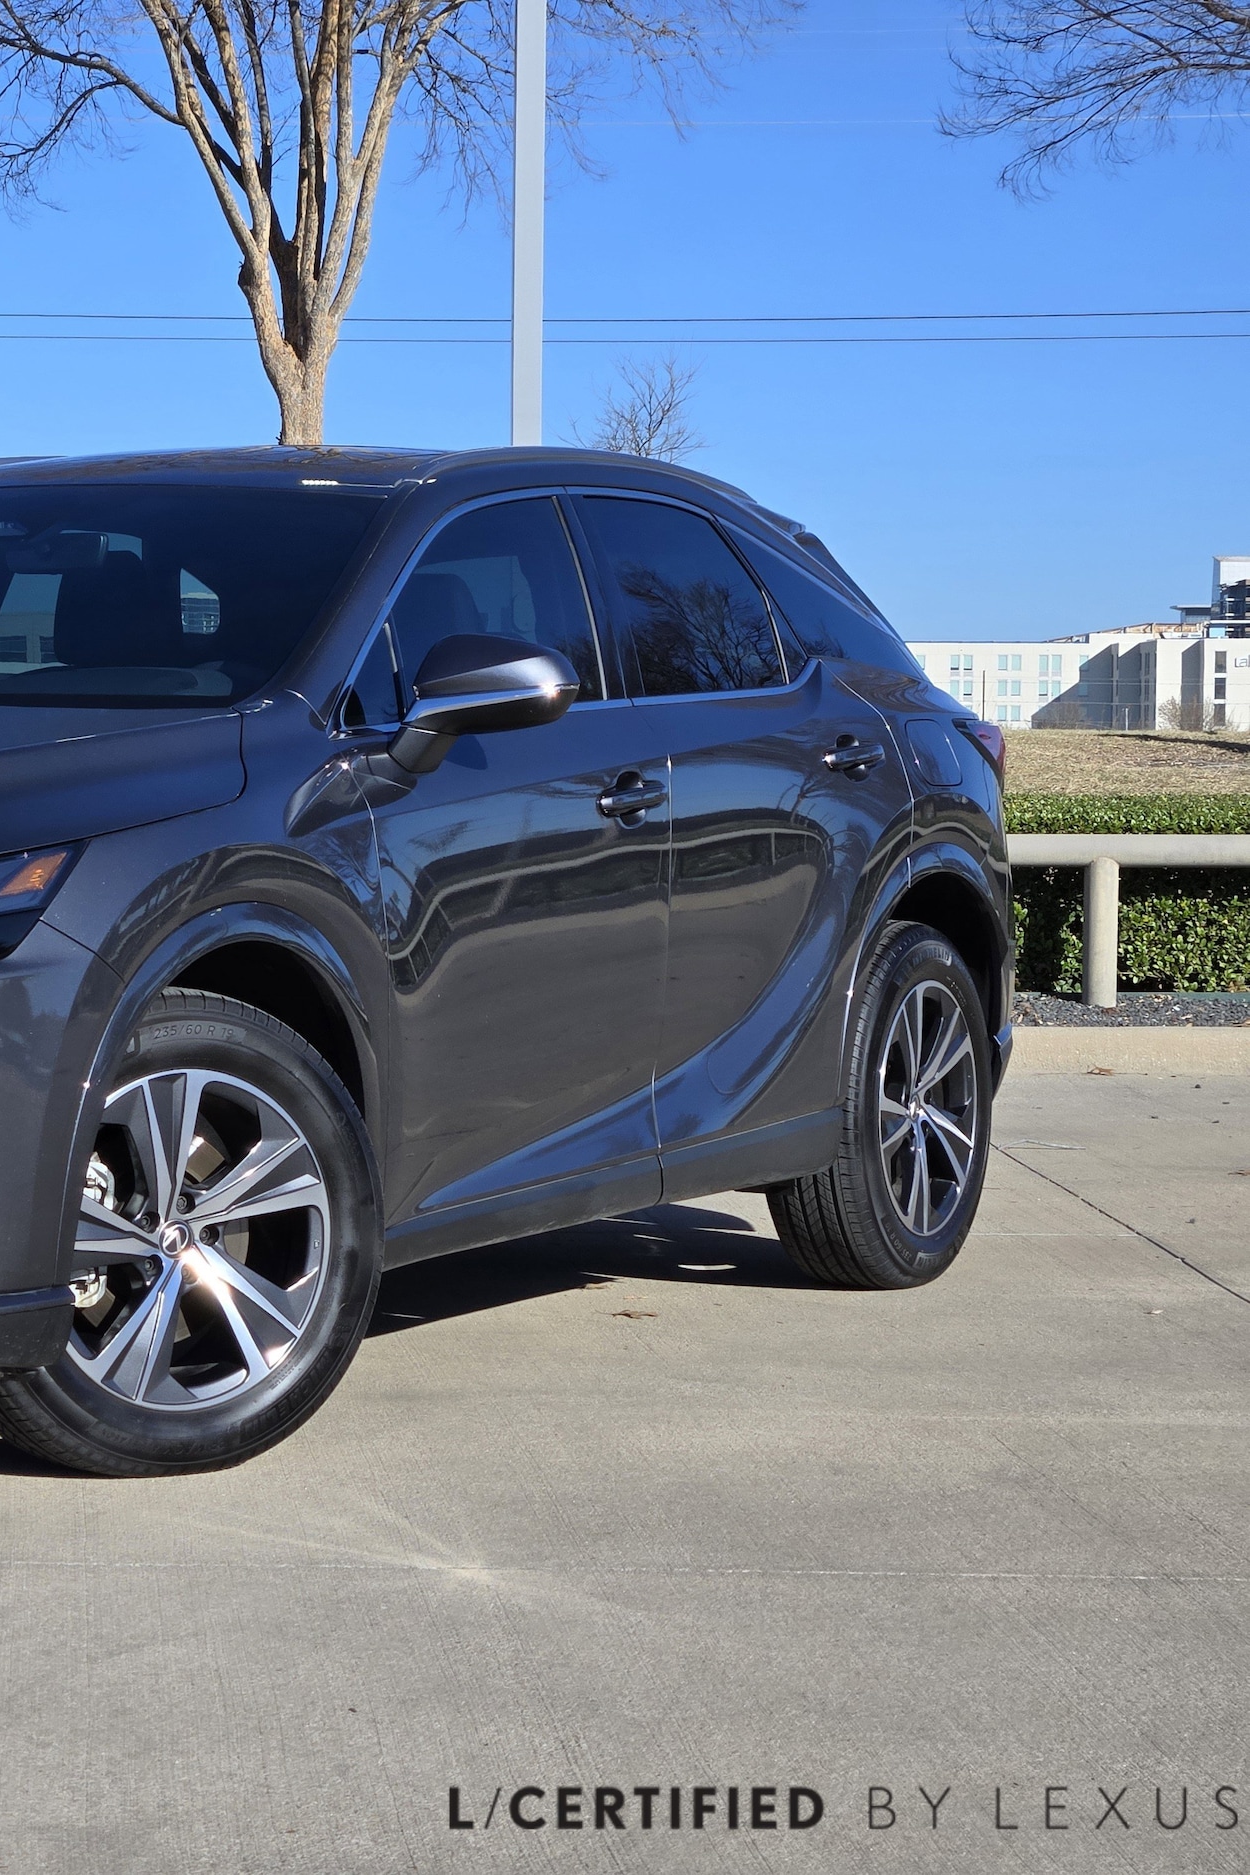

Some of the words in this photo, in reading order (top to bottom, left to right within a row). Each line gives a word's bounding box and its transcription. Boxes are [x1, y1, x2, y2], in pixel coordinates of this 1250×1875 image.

[1234, 654, 1250, 668] La
[153, 1024, 202, 1040] 235/60
[206, 1025, 216, 1036] R
